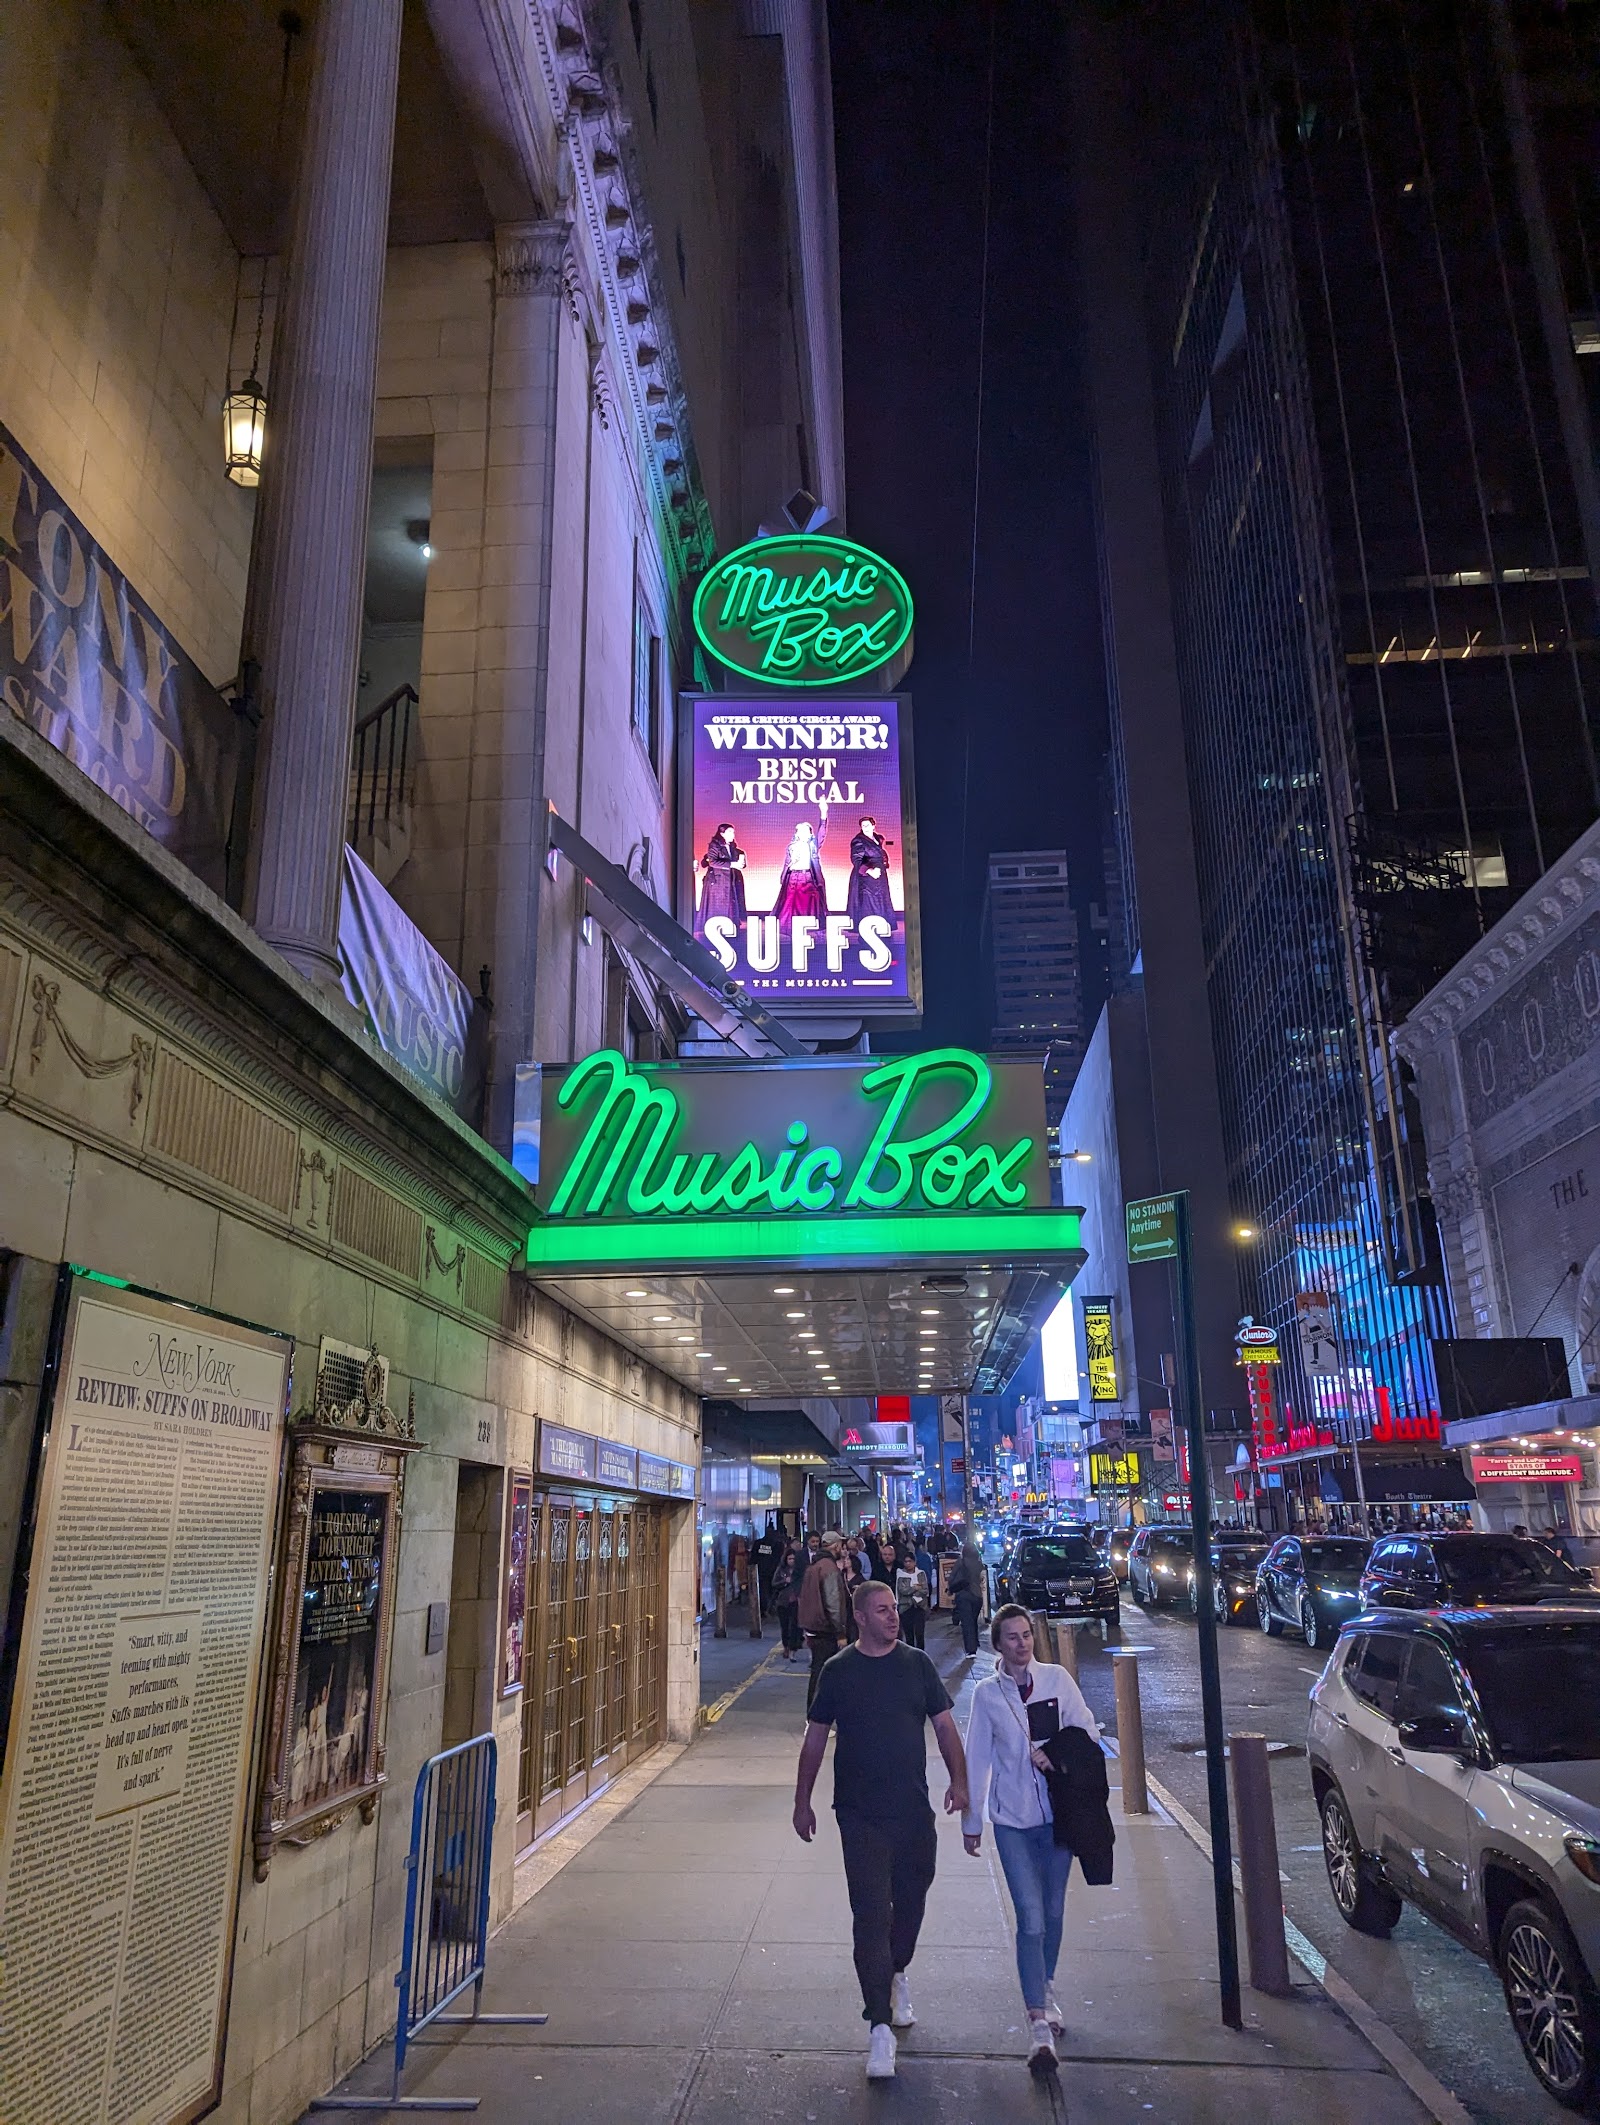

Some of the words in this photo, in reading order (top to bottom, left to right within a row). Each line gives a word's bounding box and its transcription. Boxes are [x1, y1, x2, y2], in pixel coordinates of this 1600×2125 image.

[720, 555, 879, 624] Music
[751, 607, 897, 672] Box
[711, 715, 750, 724] OUTER
[752, 715, 798, 724] CRITICS
[799, 715, 841, 724] CIRCLE
[842, 715, 882, 724] AWARD
[703, 723, 889, 750] WINNER!
[757, 757, 837, 780] BEST
[730, 781, 865, 803] MUSICAL
[704, 915, 892, 972] SUFFS
[752, 979, 779, 987] THE
[785, 979, 848, 987] MUSICAL
[547, 1048, 843, 1215] Music
[842, 1048, 1033, 1209] Box
[1549, 1168, 1589, 1209] THE
[1130, 1207, 1140, 1220] NO
[1142, 1200, 1175, 1217] STANDIN
[1131, 1219, 1162, 1234] Anytime
[1243, 1327, 1273, 1340] Junior's
[1303, 1331, 1333, 1345] MORMON
[1093, 1384, 1114, 1396] KING
[75, 1376, 141, 1411] REVIEW:
[143, 1389, 190, 1418] SUFFS
[190, 1399, 209, 1423] ON
[210, 1403, 274, 1432] BROADWAY
[153, 1421, 164, 1430] BY
[164, 1422, 183, 1434] SARA
[183, 1425, 213, 1437] HOLDREN
[601, 1462, 610, 1475] FOR
[1487, 1469, 1527, 1477] DIFFERENT
[1407, 1492, 1433, 1500] Theatre
[325, 1511, 368, 1535] ROUSING
[317, 1535, 375, 1558] DOWNRIGHT
[175, 1629, 188, 1644] and
[121, 1657, 151, 1675] teeming
[152, 1654, 167, 1669] with
[167, 1651, 191, 1667] mighty
[110, 1707, 132, 1724] Suffs
[133, 1701, 164, 1719] marches
[165, 1696, 180, 1711] with
[180, 1695, 189, 1708] its
[105, 1733, 124, 1749] head
[125, 1731, 135, 1745] up
[136, 1724, 150, 1740] and
[151, 1721, 170, 1736] heart
[116, 1752, 129, 1770] It's
[130, 1748, 144, 1764] full
[144, 1747, 152, 1761] of
[153, 1744, 173, 1760] nerve
[123, 1774, 138, 1792] and
